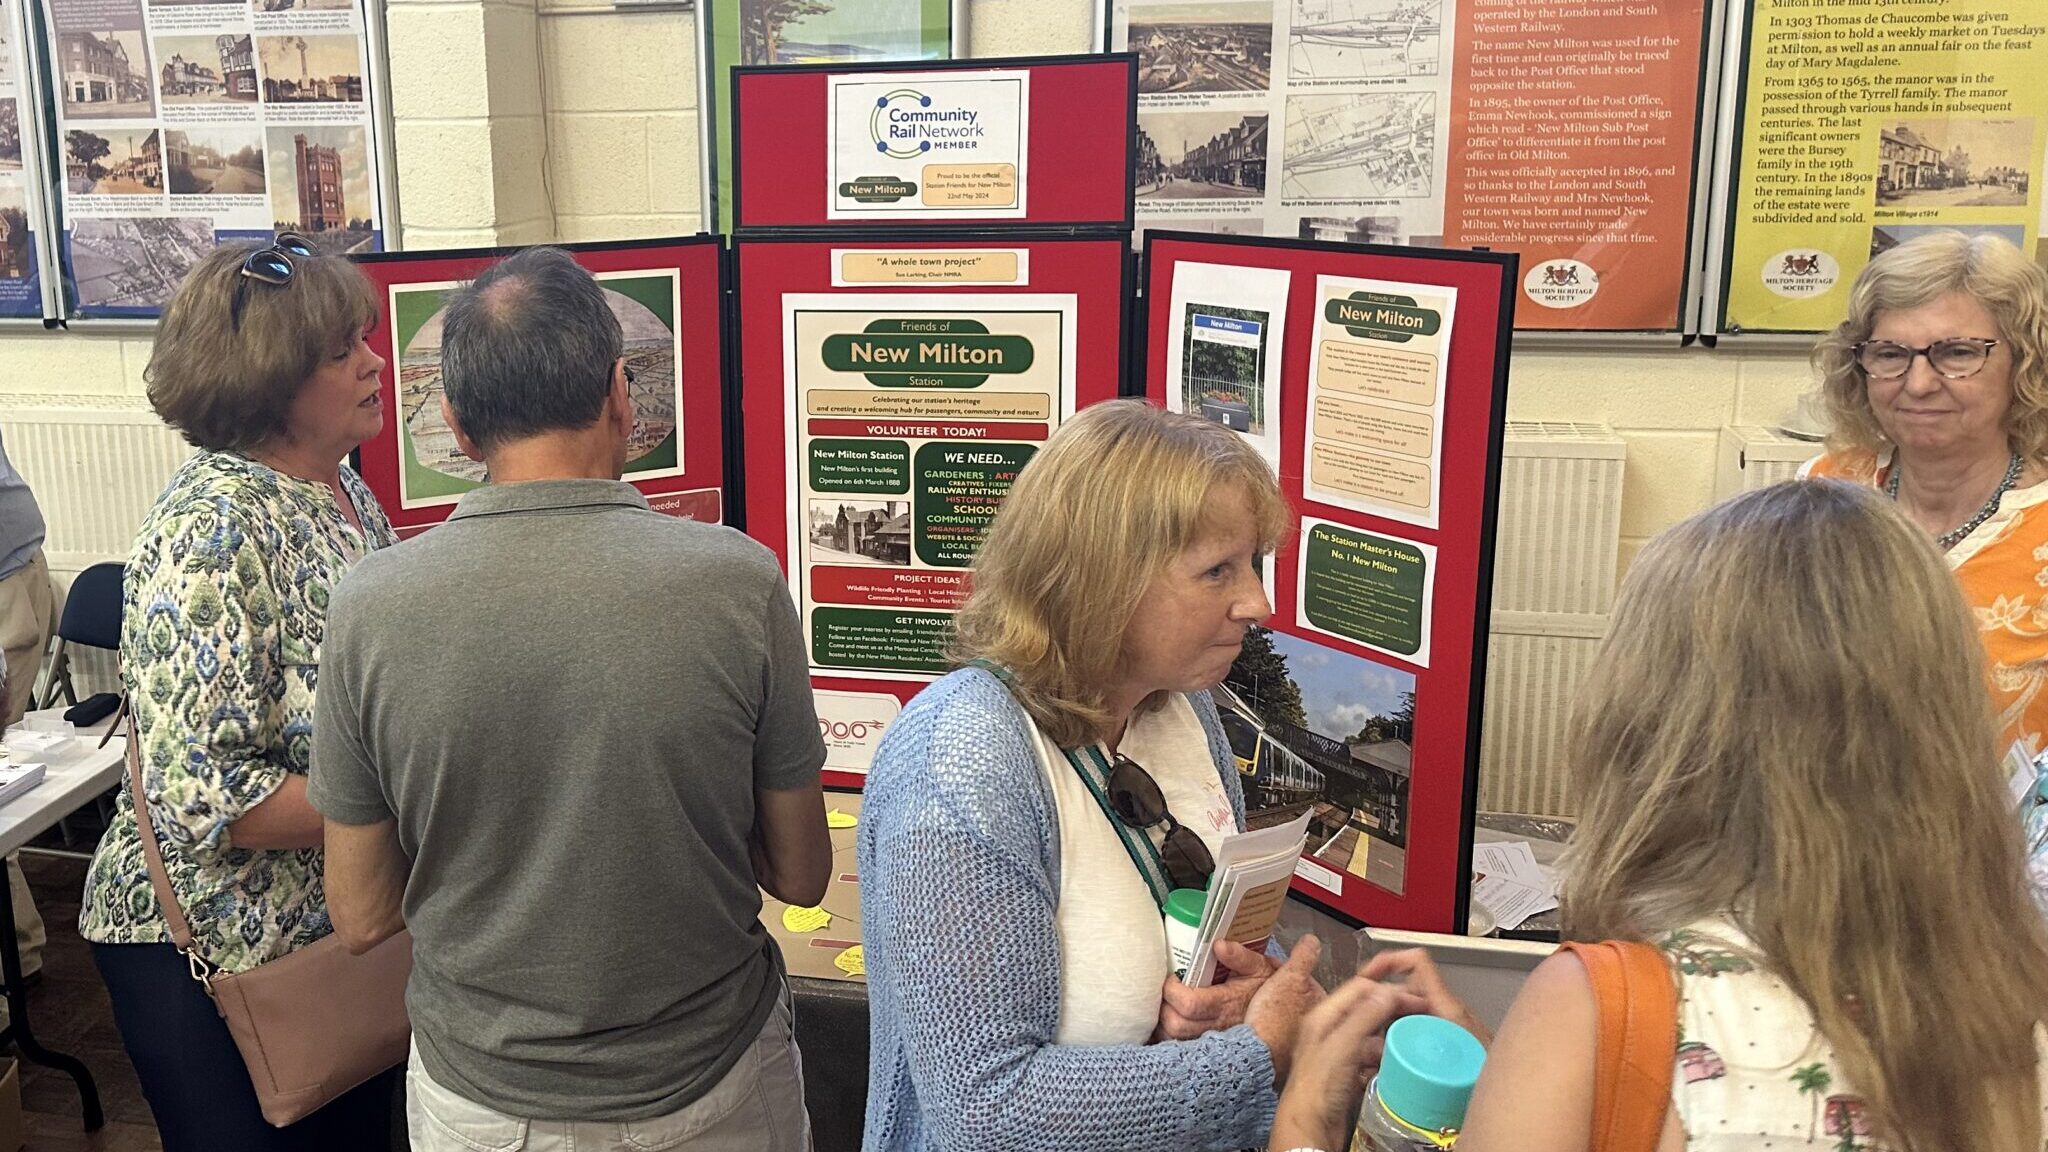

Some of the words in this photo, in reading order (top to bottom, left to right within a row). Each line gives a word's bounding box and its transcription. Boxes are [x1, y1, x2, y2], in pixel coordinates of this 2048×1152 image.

[1769, 16, 1782, 26] In
[1785, 18, 1812, 28] 1303
[1815, 14, 1861, 25] Thomas
[1864, 14, 1878, 24] de
[1880, 12, 1949, 24] Chaucombe
[1976, 11, 2008, 24] given
[1768, 28, 1831, 42] permission
[1834, 28, 1845, 38] to
[1848, 27, 1874, 38] hold
[1887, 26, 1926, 39] weekly
[1929, 25, 1970, 36] market
[1993, 24, 2046, 38] Tuesdays
[1471, 40, 1492, 50] The
[1526, 39, 1551, 49] New
[1553, 38, 1589, 49] Milton
[1614, 37, 1640, 48] used
[1642, 37, 1659, 47] for
[1661, 36, 1679, 47] the
[1471, 53, 1492, 64] first
[1495, 53, 1518, 63] time
[1522, 53, 1541, 63] and
[1565, 52, 1616, 65] originally
[1619, 51, 1631, 61] be
[1635, 51, 1668, 61] traced
[1765, 57, 1786, 70] day
[1787, 57, 1799, 67] of
[1802, 57, 1832, 70] Mary
[1835, 56, 1900, 69] Magdalene.
[1470, 67, 1494, 77] back
[1497, 67, 1508, 77] to
[1510, 66, 1527, 77] the
[1530, 66, 1552, 76] Post
[1555, 66, 1587, 76] Office
[1590, 65, 1611, 75] that
[1614, 65, 1644, 75] stood
[889, 108, 977, 124] Community
[890, 124, 916, 138] Rail
[919, 122, 984, 137] Network
[850, 185, 870, 194] New
[875, 184, 906, 194] Milton
[1368, 294, 1387, 302] Friends
[1339, 305, 1370, 321] New
[1376, 308, 1423, 328] Milton
[901, 321, 936, 331] Friends
[939, 321, 950, 331] of
[1211, 320, 1222, 328] New
[1224, 321, 1242, 331] Milton
[1368, 331, 1388, 340] Station
[851, 343, 909, 362] New
[920, 343, 1003, 364] Milton
[909, 376, 943, 386] Station
[872, 396, 909, 404] Celebrating
[867, 426, 938, 436] VOLUNTEER
[943, 427, 986, 437] TODAY!
[838, 451, 867, 459] Milton
[871, 452, 904, 460] Station
[945, 453, 964, 462] WE
[925, 471, 984, 479] GARDENERS
[651, 500, 680, 510] needed
[1314, 530, 1329, 541] The
[1331, 534, 1357, 548] Station
[1360, 542, 1392, 556] Master's
[1394, 551, 1420, 563] House
[1331, 550, 1344, 559] No.
[1352, 555, 1370, 566] New
[1372, 562, 1397, 573] Milton
[935, 575, 960, 584] IDEAS
